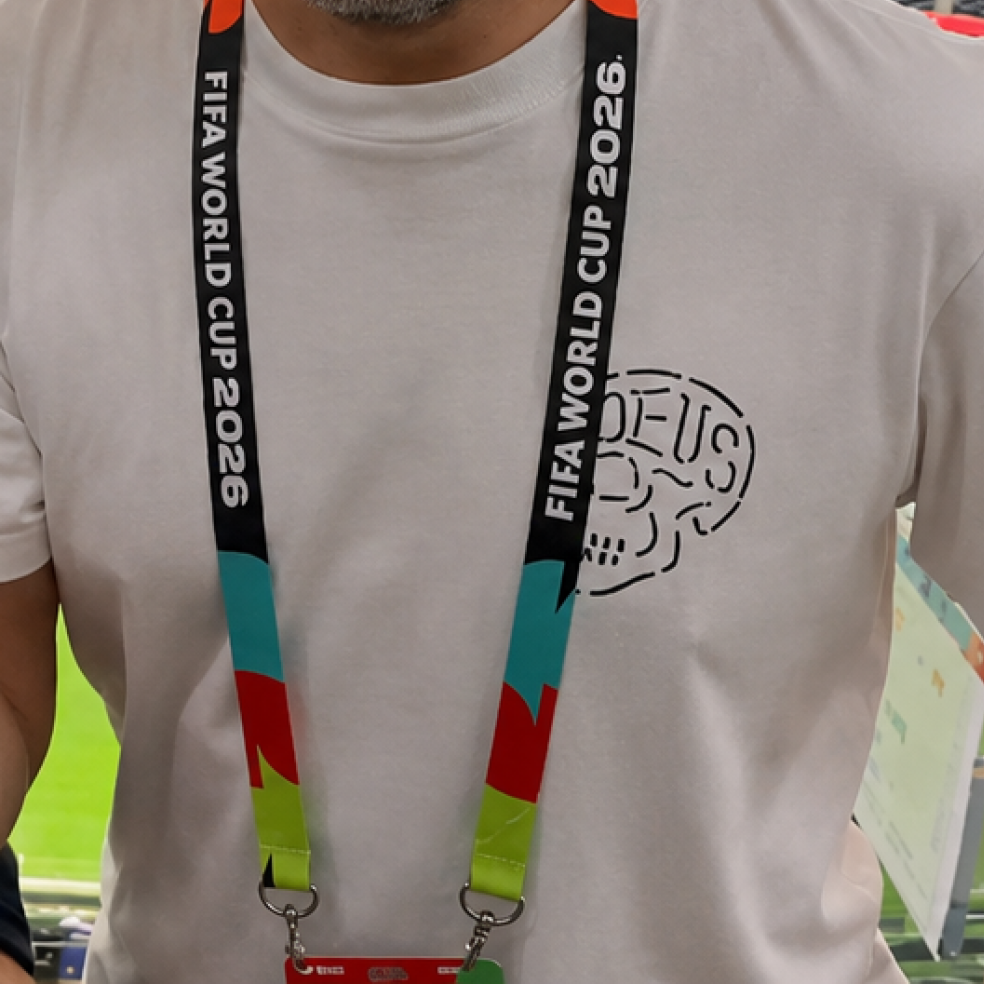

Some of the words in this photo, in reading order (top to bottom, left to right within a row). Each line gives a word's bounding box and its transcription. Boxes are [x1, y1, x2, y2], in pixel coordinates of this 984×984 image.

[203, 72, 227, 148] FIFA
[202, 152, 231, 286] WORLD
[577, 206, 611, 282] CUP
[208, 297, 236, 369] CUP
[558, 291, 602, 432] WORLD
[214, 379, 248, 507] 2026
[545, 440, 584, 520] FIFA
